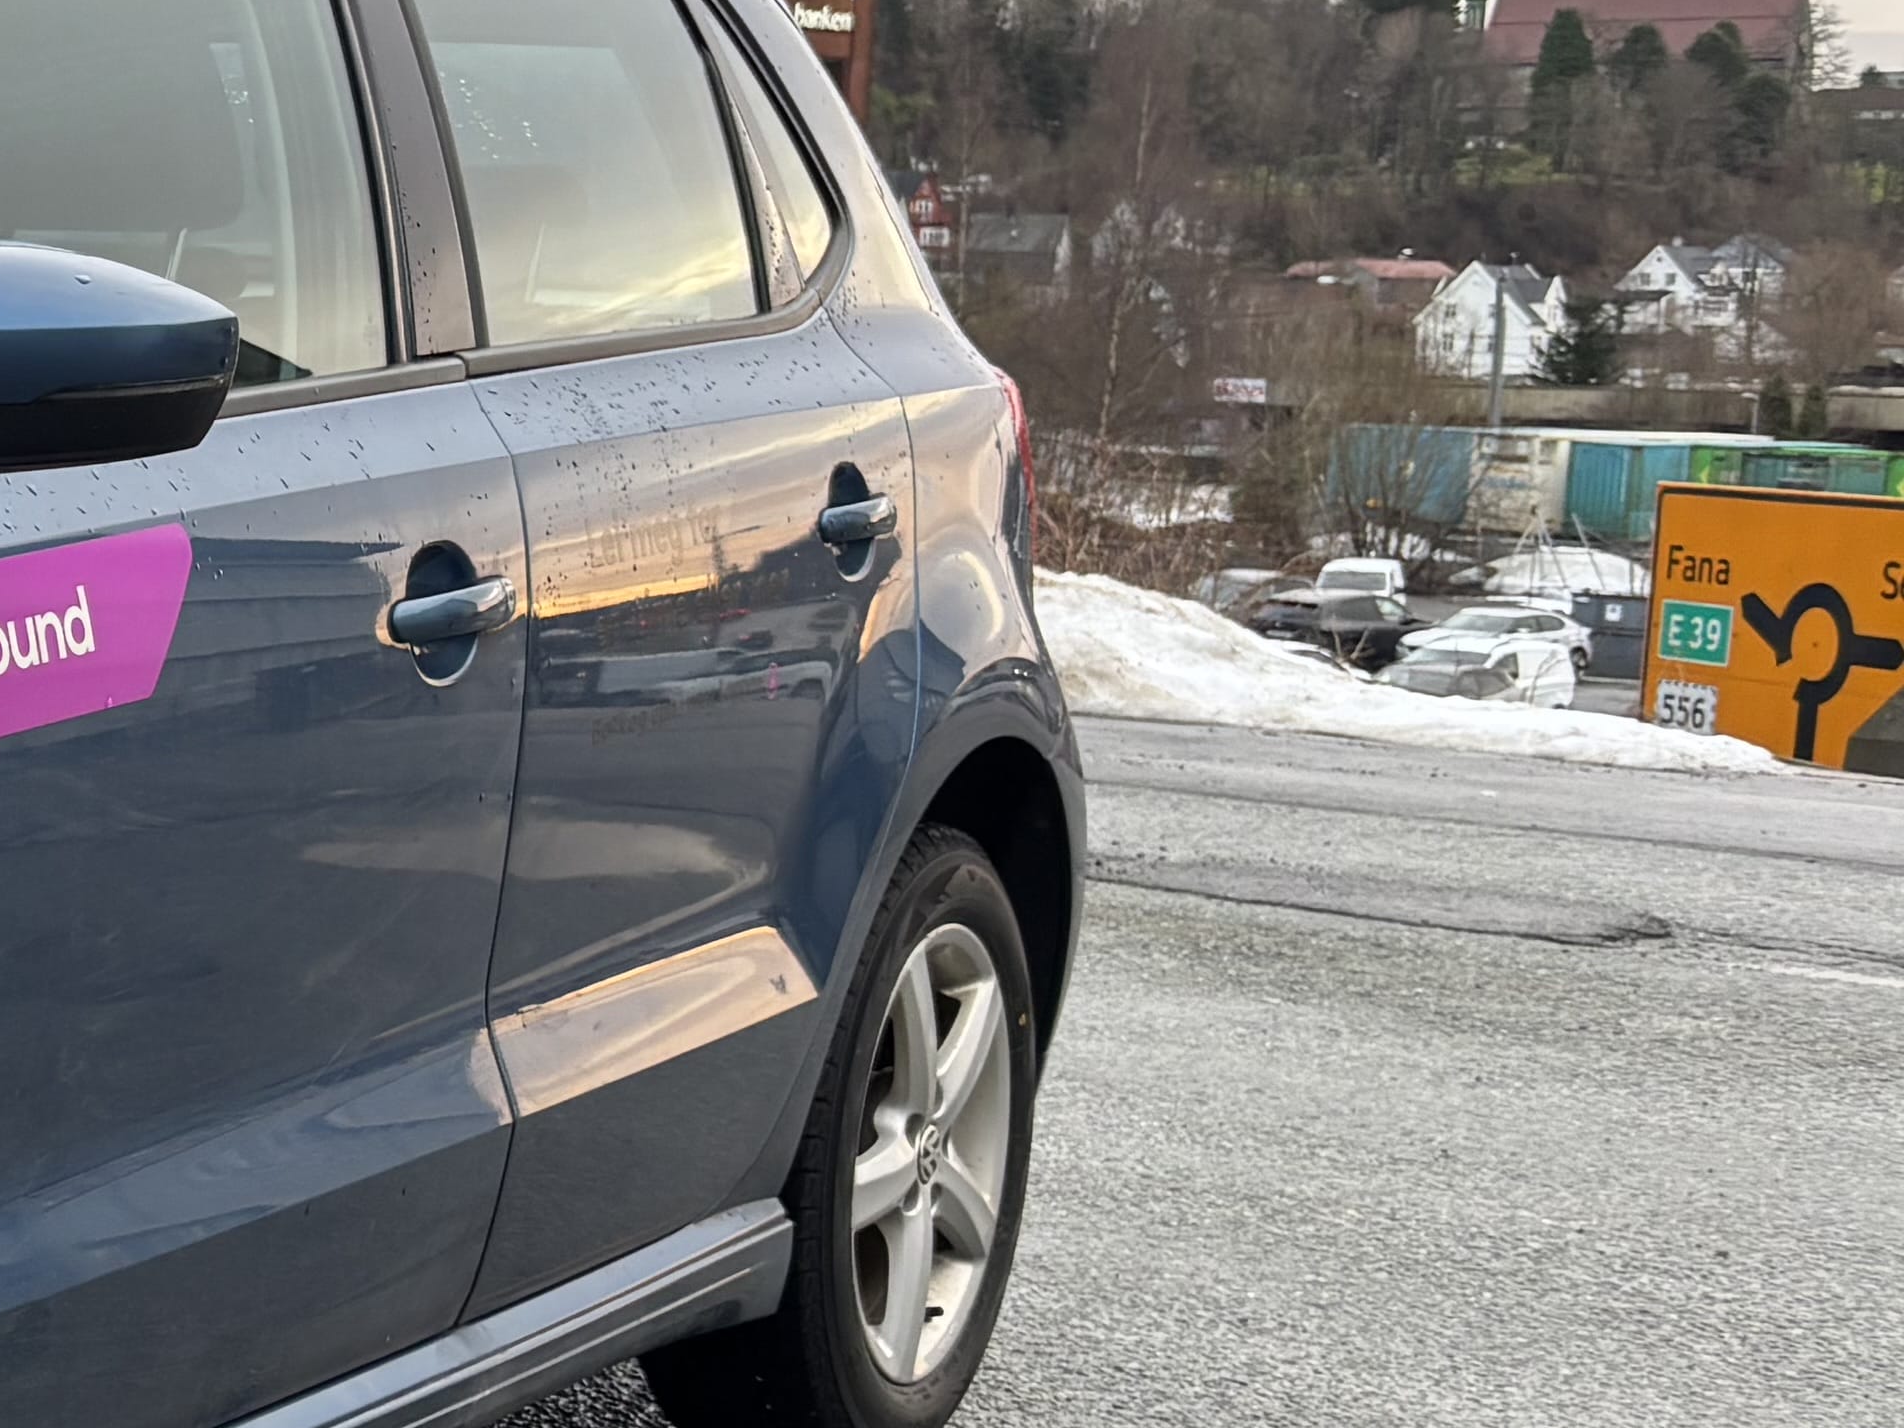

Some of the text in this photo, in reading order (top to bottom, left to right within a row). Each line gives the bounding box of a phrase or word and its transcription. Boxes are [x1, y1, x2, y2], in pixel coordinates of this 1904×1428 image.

[1666, 544, 1731, 586] Fana
[1880, 560, 1904, 601] S
[1667, 613, 1723, 653] E 39
[1661, 693, 1708, 730] 556
